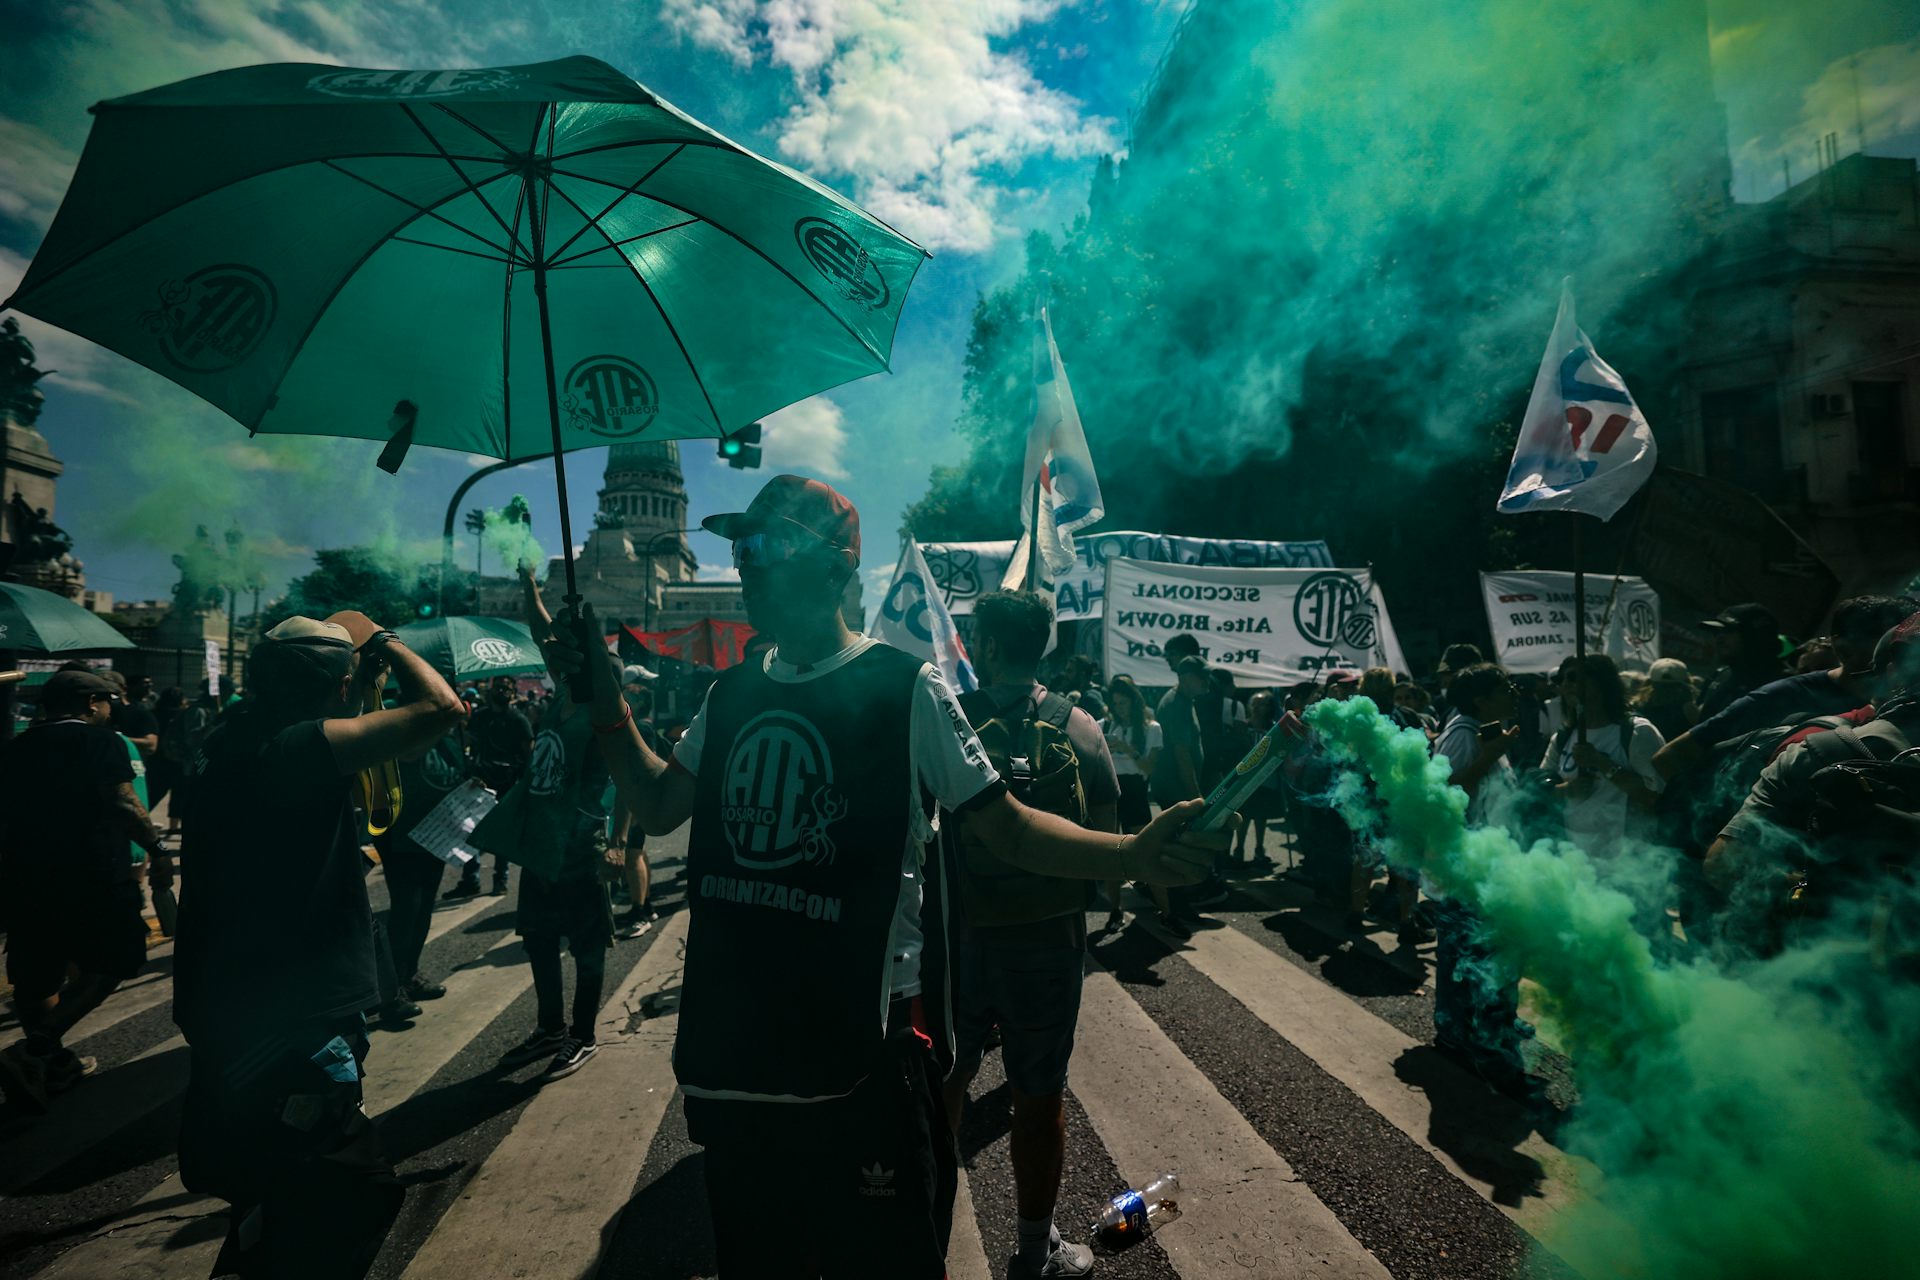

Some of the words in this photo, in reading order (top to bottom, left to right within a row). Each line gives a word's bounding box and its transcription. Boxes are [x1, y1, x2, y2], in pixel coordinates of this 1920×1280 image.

[941, 700, 988, 772] ADELANTE
[721, 806, 777, 825] ROSARIO
[726, 726, 818, 853] ATE
